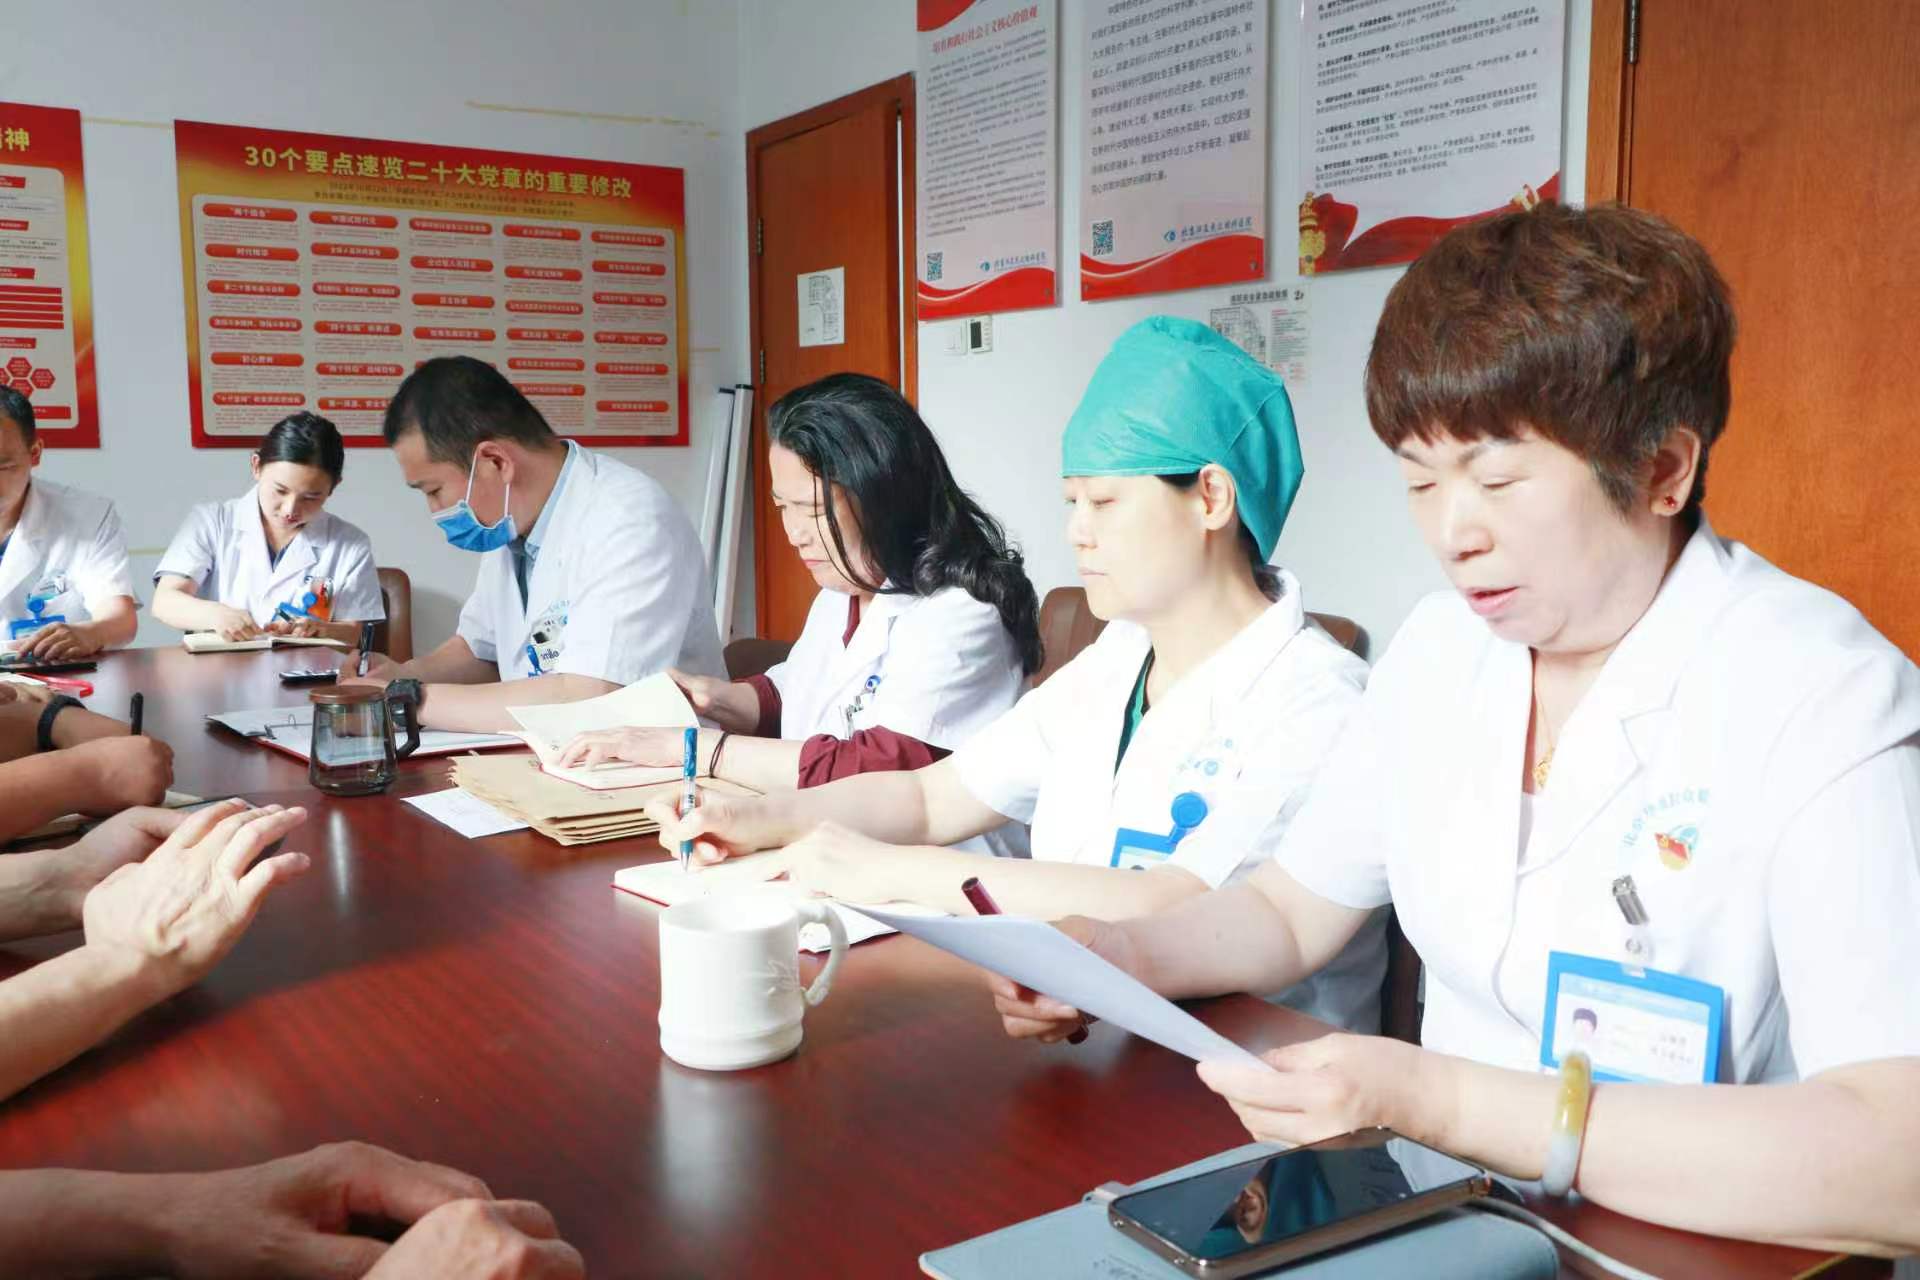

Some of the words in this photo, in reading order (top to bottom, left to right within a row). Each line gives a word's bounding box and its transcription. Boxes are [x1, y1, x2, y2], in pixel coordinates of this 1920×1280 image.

[0, 127, 30, 152] 神
[244, 146, 632, 198] 30个要点速览二十大党章的重要修改
